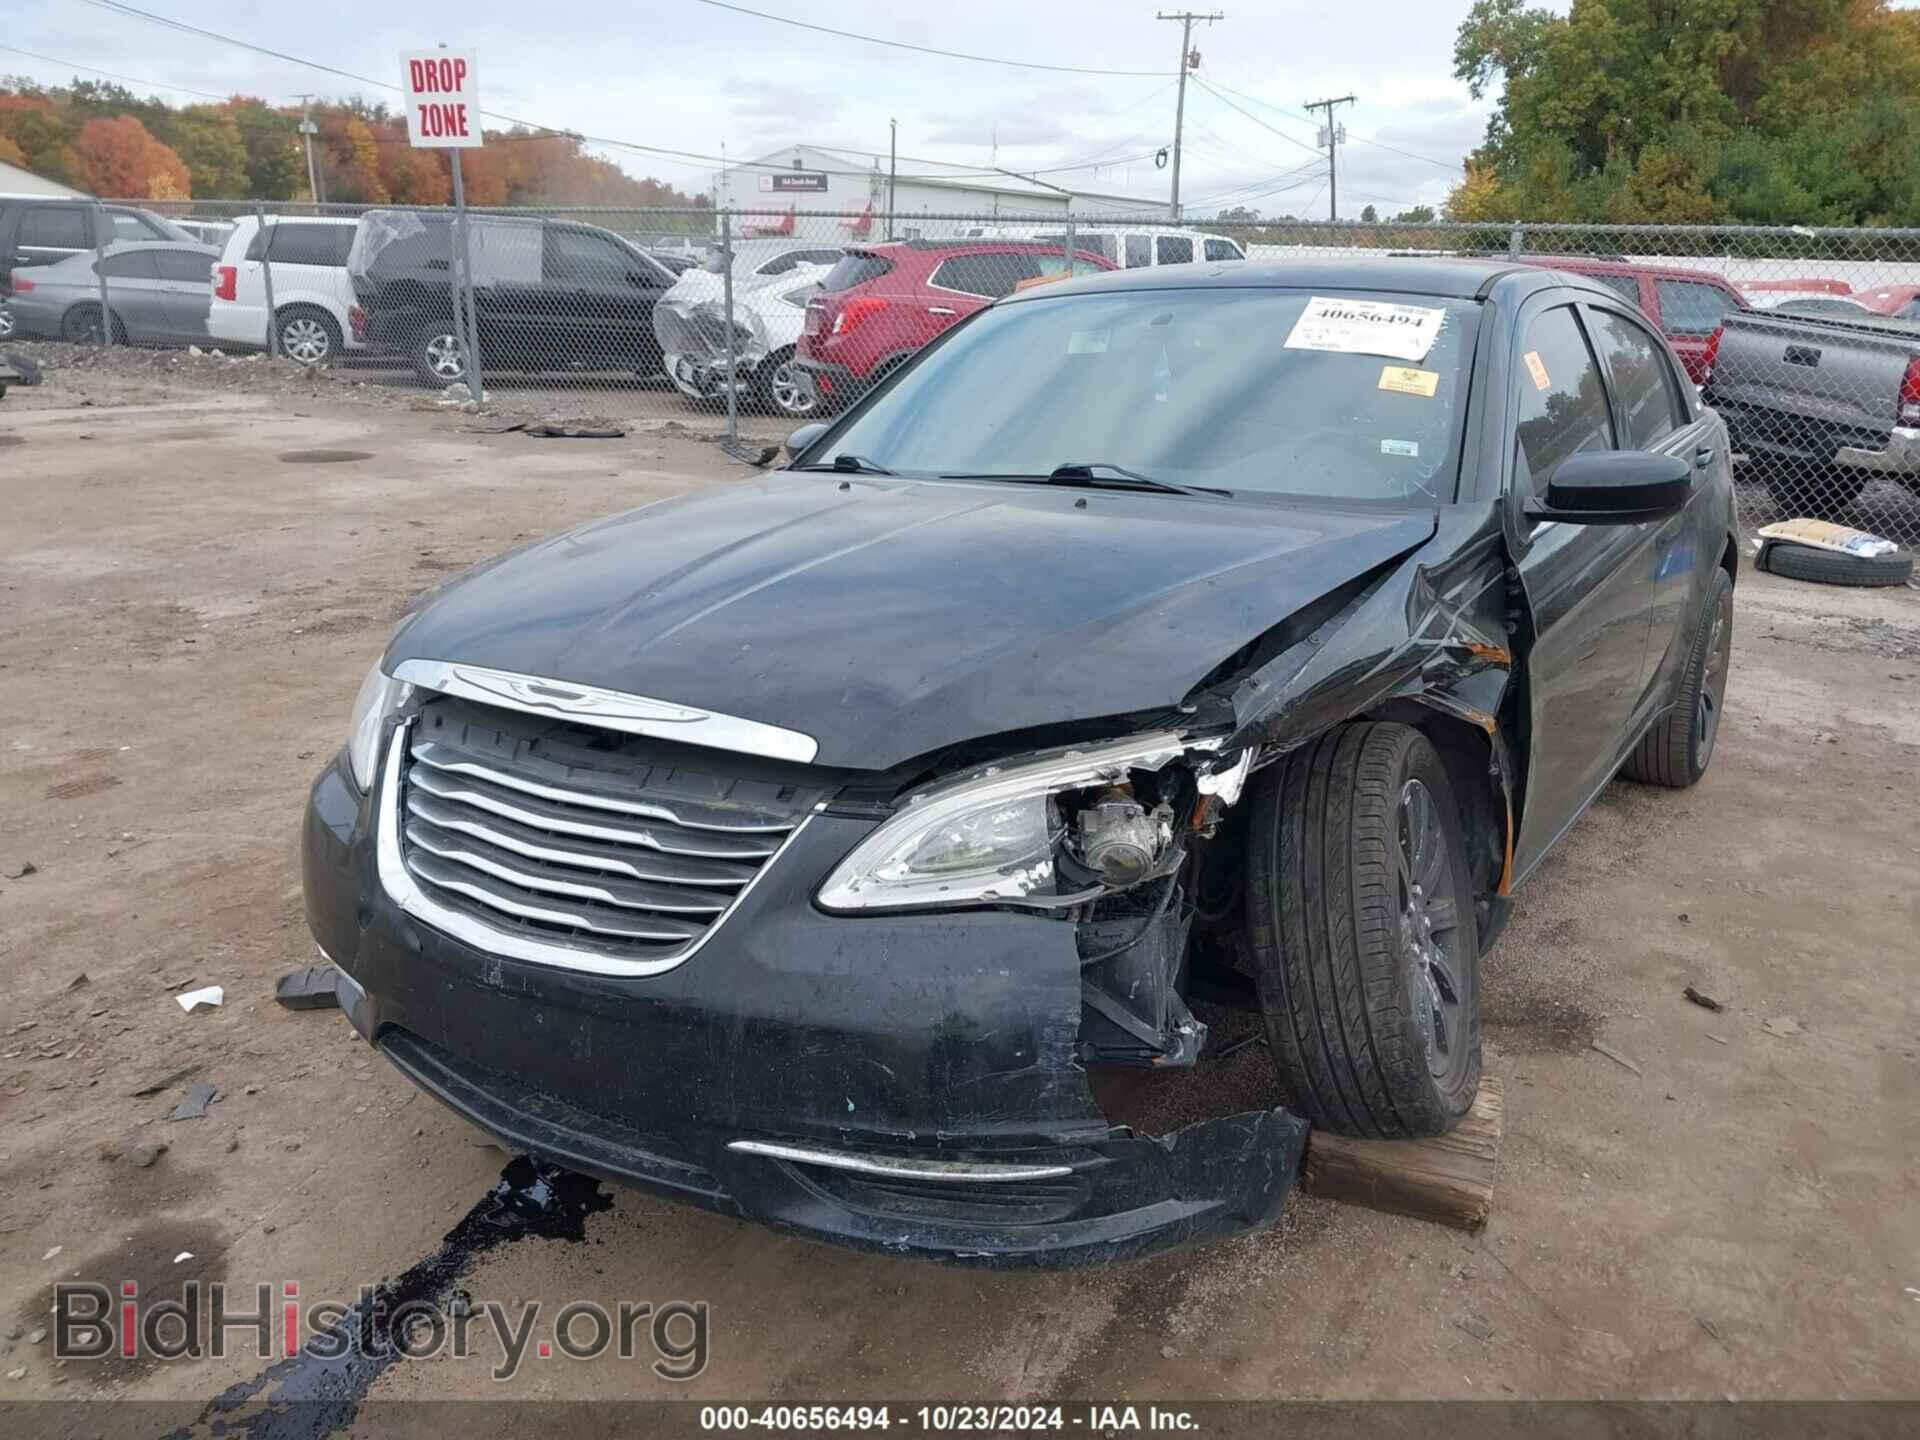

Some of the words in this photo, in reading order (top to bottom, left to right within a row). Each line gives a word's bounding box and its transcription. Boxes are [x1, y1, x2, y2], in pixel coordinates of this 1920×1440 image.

[409, 58, 466, 93] DROP
[418, 103, 469, 136] ZONE
[1315, 308, 1425, 328] 40656494
